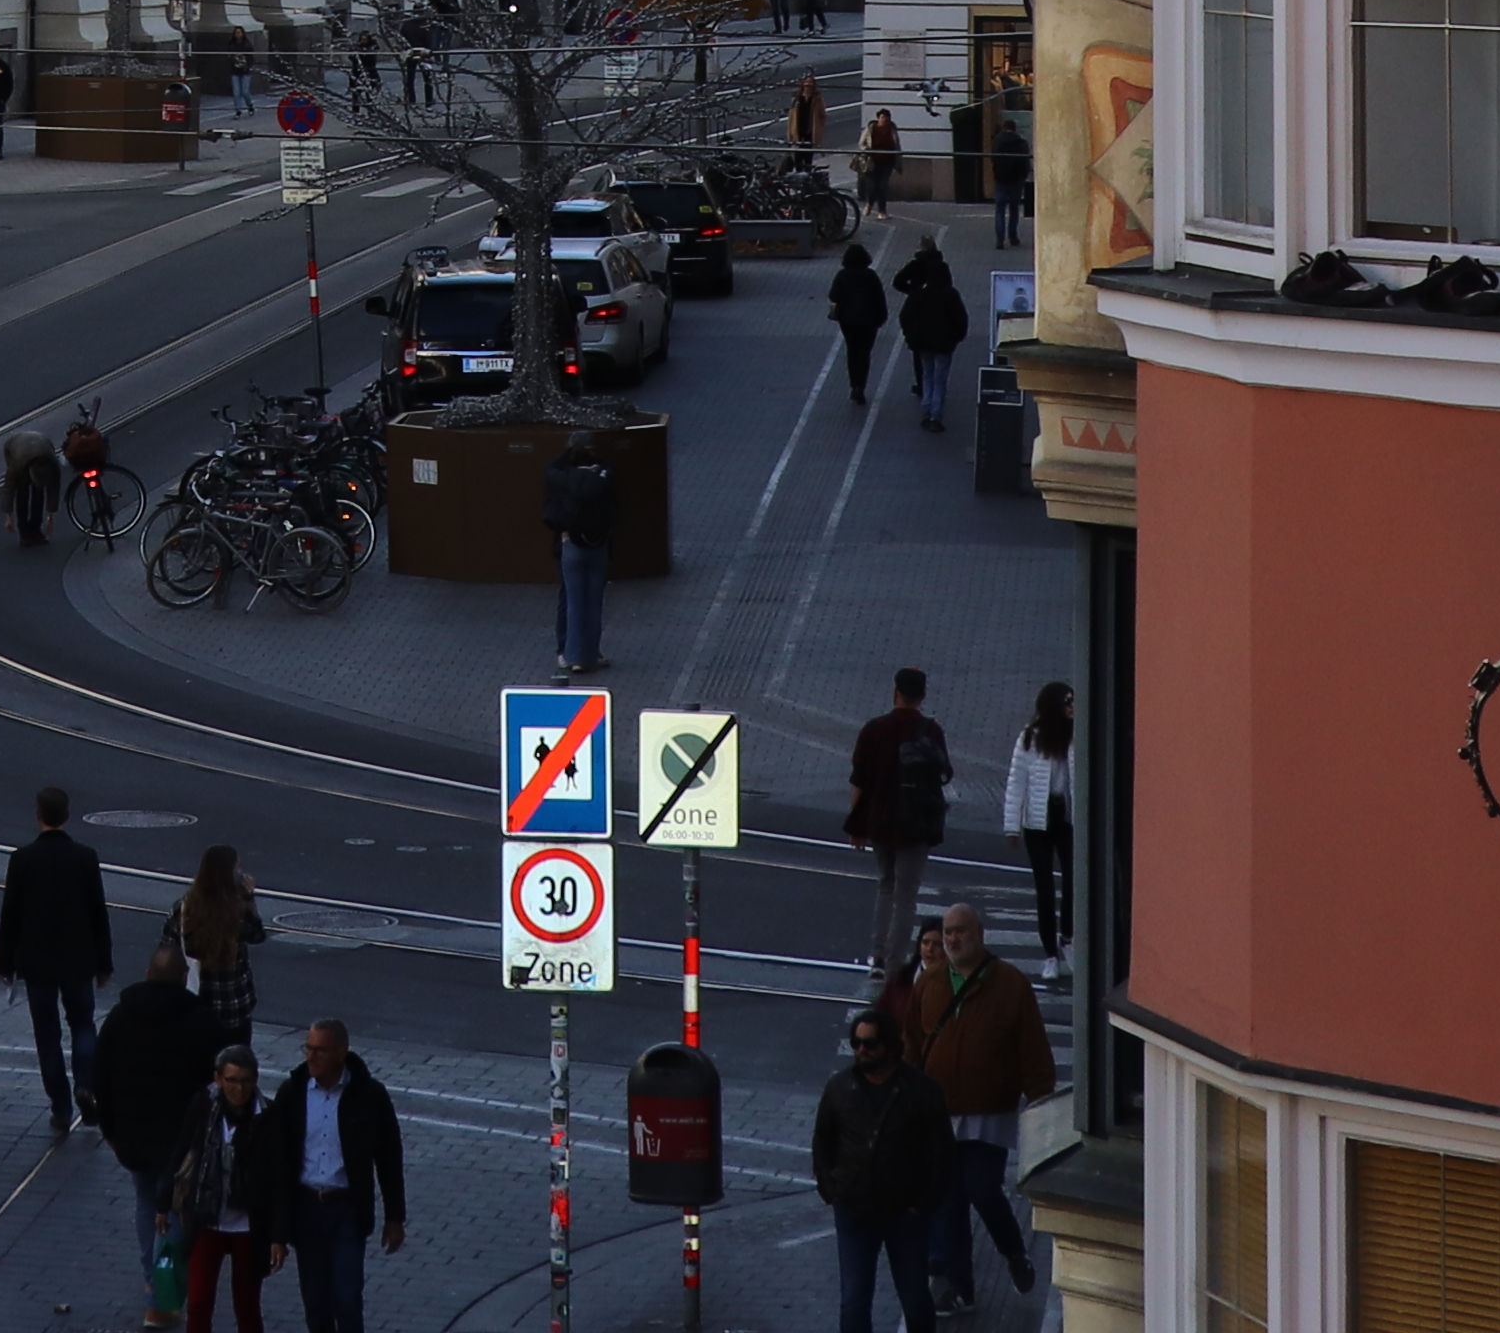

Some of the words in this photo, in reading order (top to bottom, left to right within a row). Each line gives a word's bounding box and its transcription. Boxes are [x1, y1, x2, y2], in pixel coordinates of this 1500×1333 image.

[416, 249, 447, 257] KAPLAN
[662, 829, 715, 841] 06:00-10:30
[540, 876, 577, 916] 30
[524, 952, 593, 983] Zone
